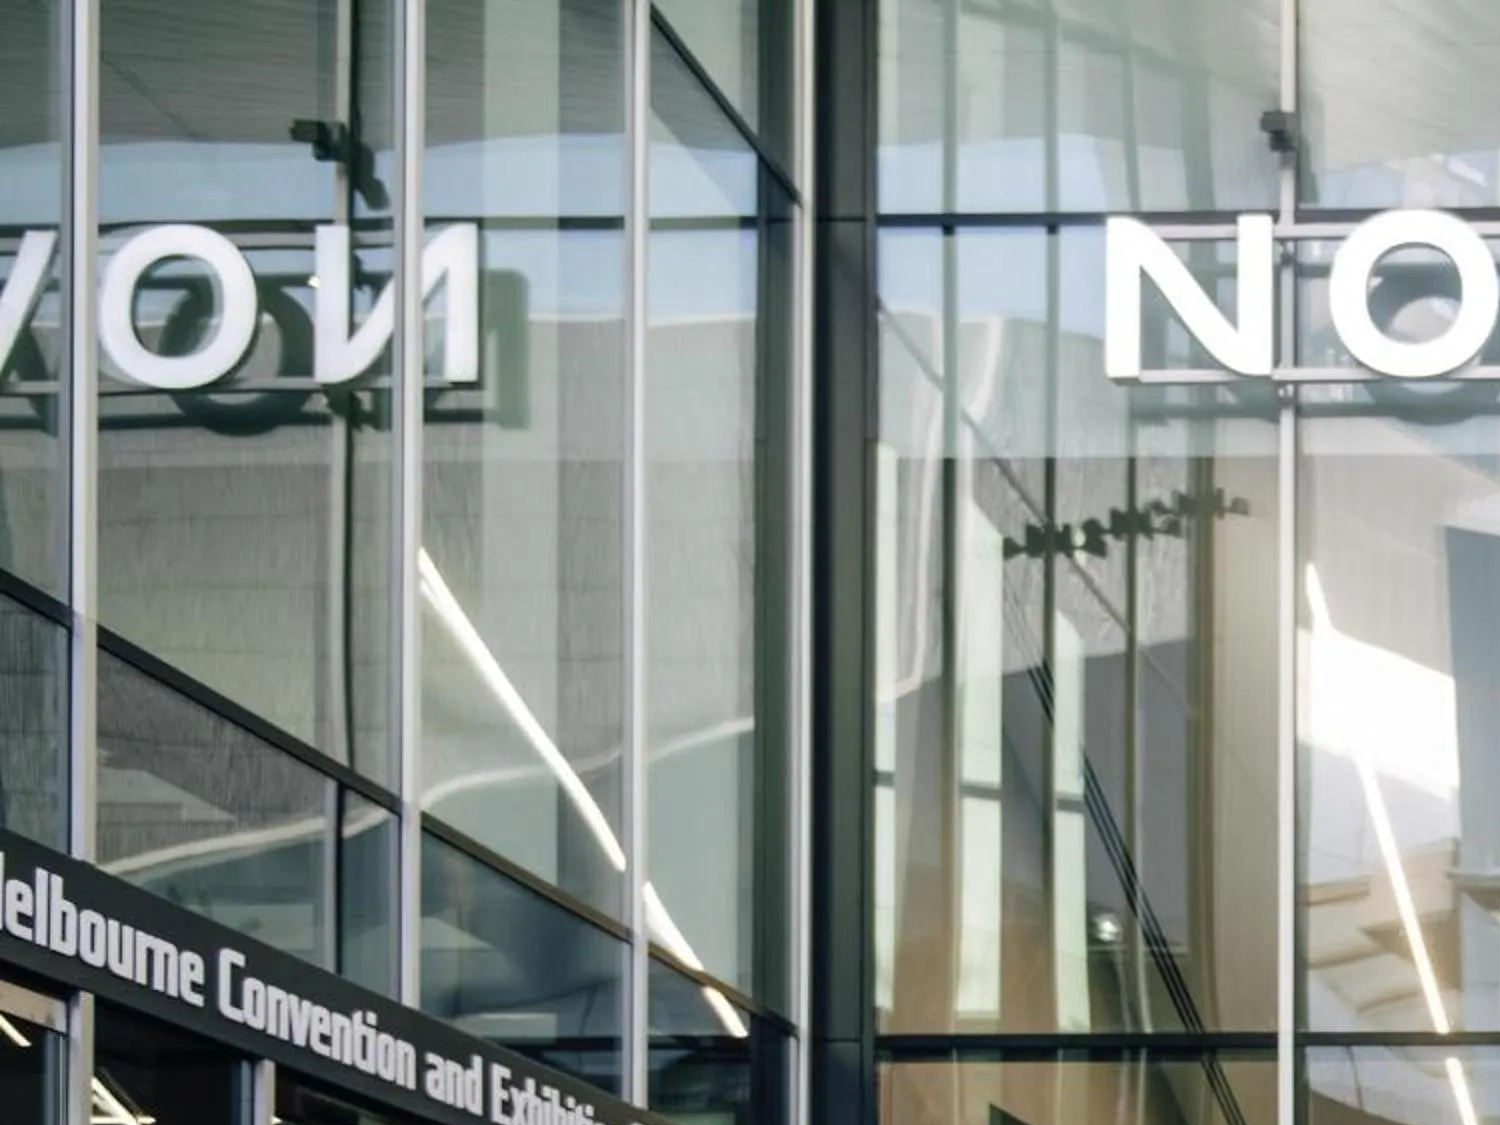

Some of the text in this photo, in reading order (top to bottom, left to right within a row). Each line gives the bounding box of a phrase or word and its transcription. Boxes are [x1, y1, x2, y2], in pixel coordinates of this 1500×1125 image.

[0, 851, 205, 1008] elbourne
[218, 947, 417, 1091] Convention
[424, 1052, 484, 1117] and
